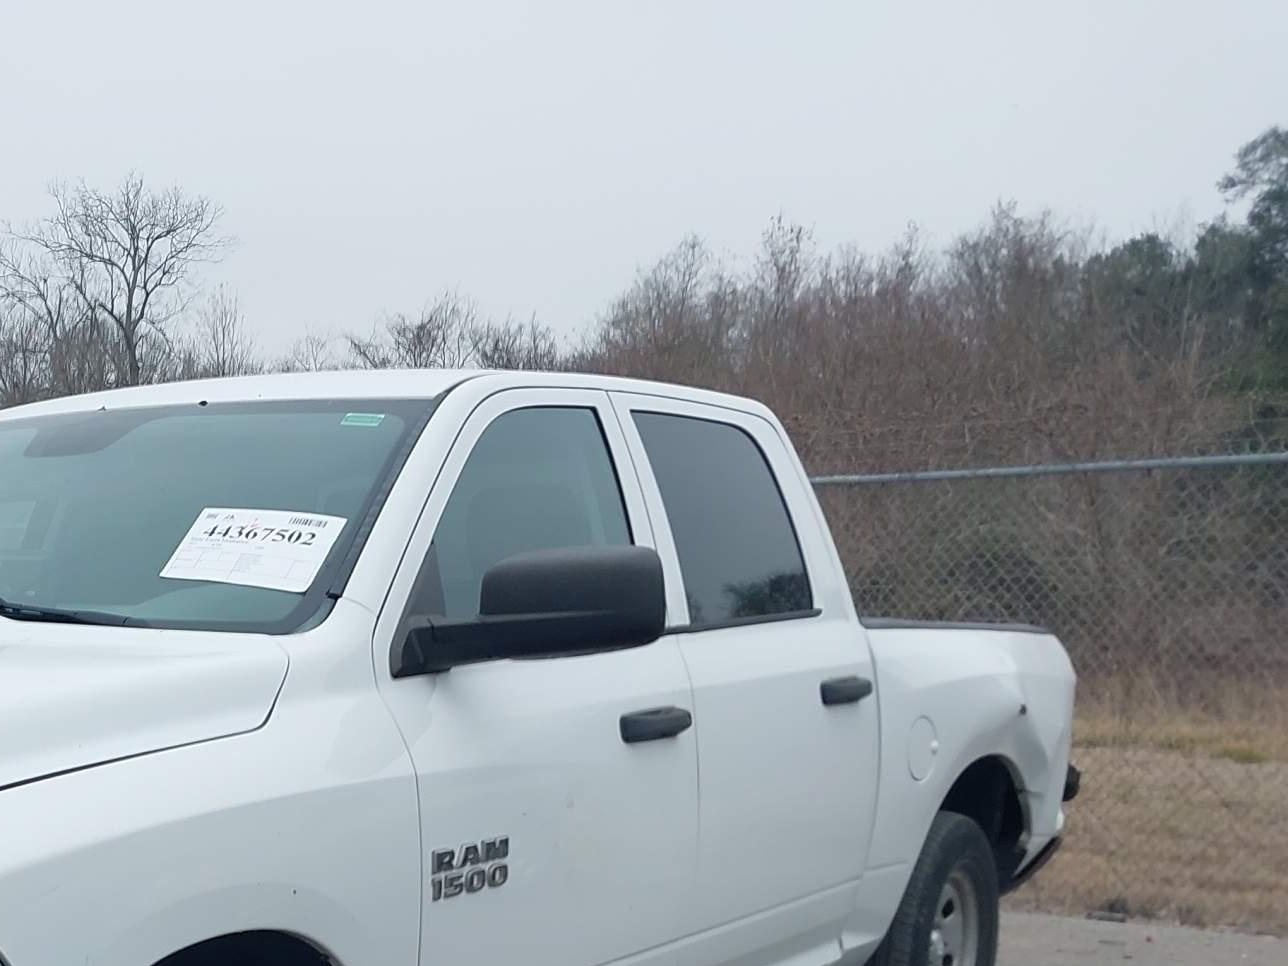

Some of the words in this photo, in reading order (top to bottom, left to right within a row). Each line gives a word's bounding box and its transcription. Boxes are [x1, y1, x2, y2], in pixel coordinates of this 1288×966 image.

[203, 524, 316, 546] 44367502
[431, 836, 509, 875] RAM
[431, 863, 508, 902] 1500
